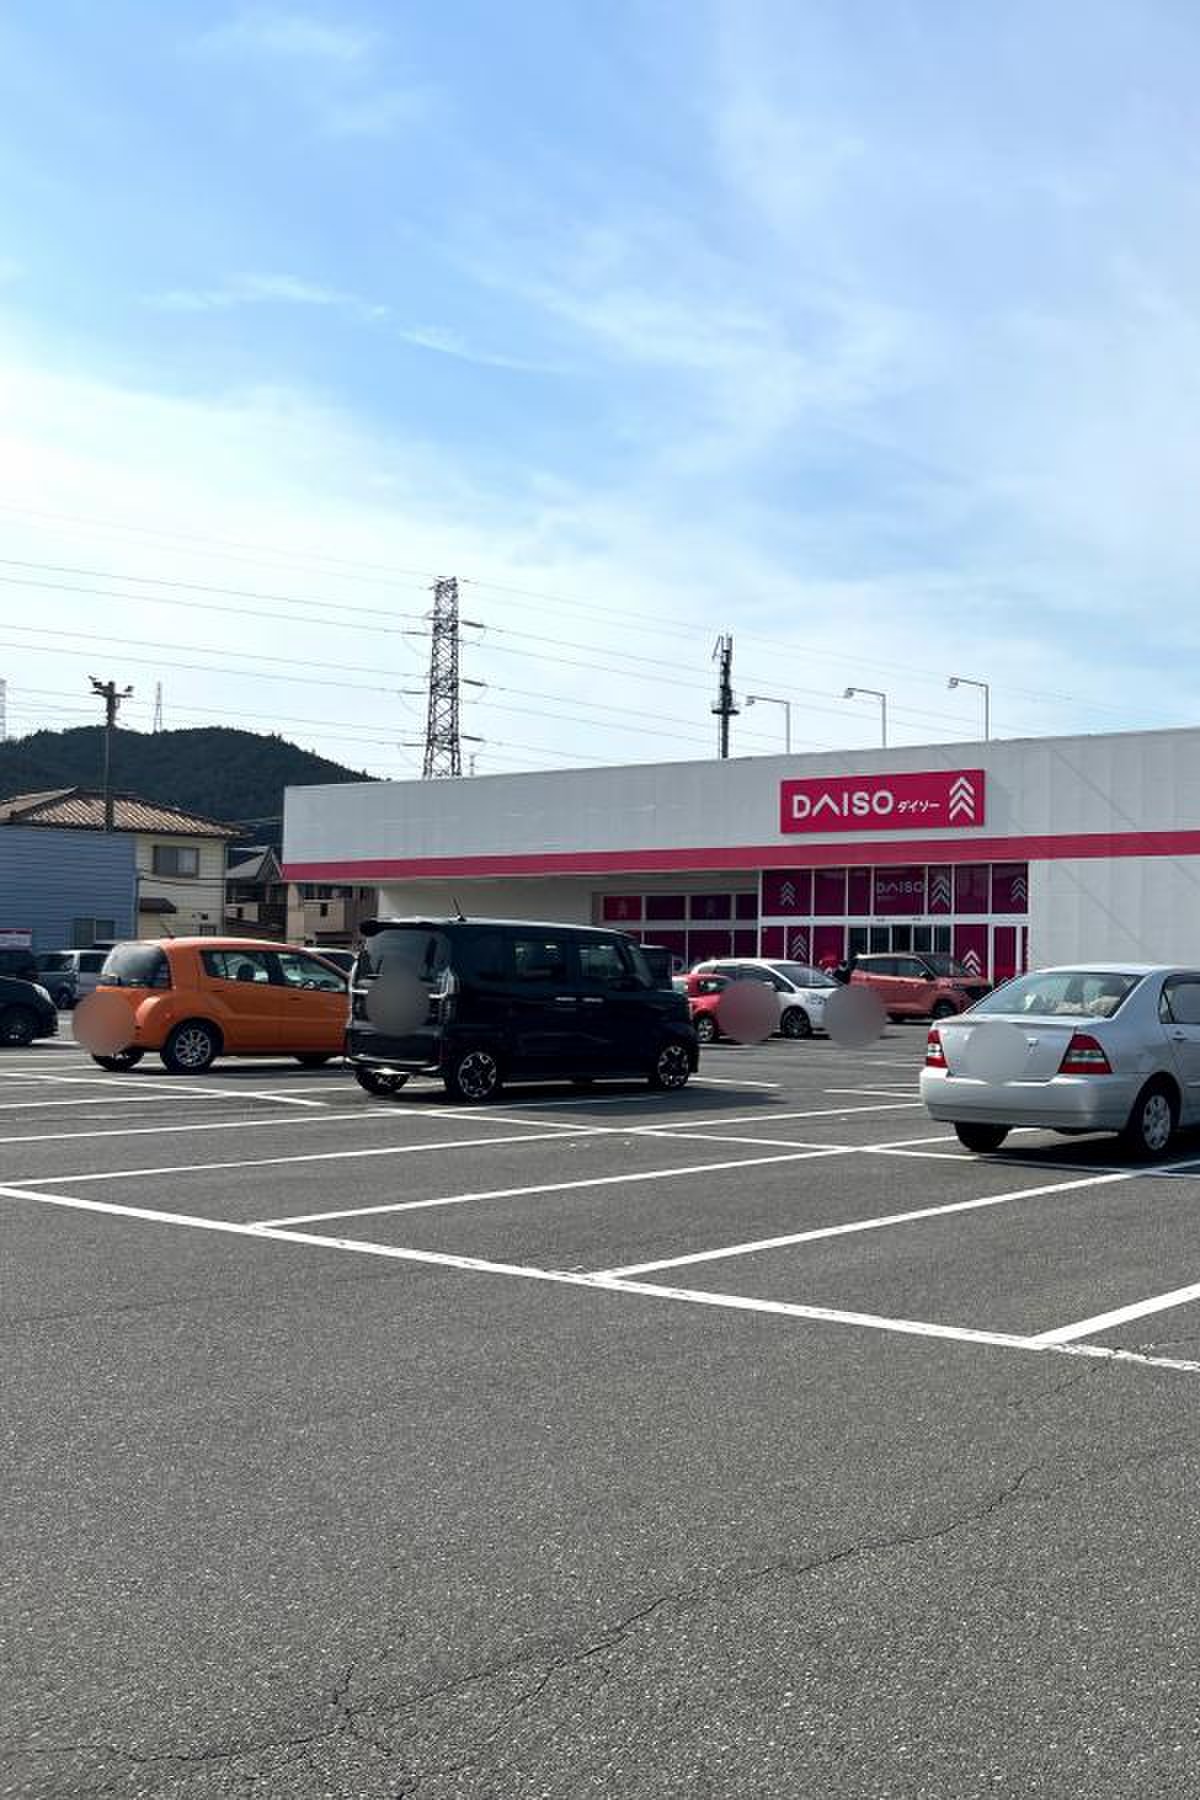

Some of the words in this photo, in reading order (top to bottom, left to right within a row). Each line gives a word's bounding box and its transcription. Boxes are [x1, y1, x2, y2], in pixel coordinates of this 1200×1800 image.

[792, 790, 894, 819] DAISO
[897, 800, 940, 814] ダイソー
